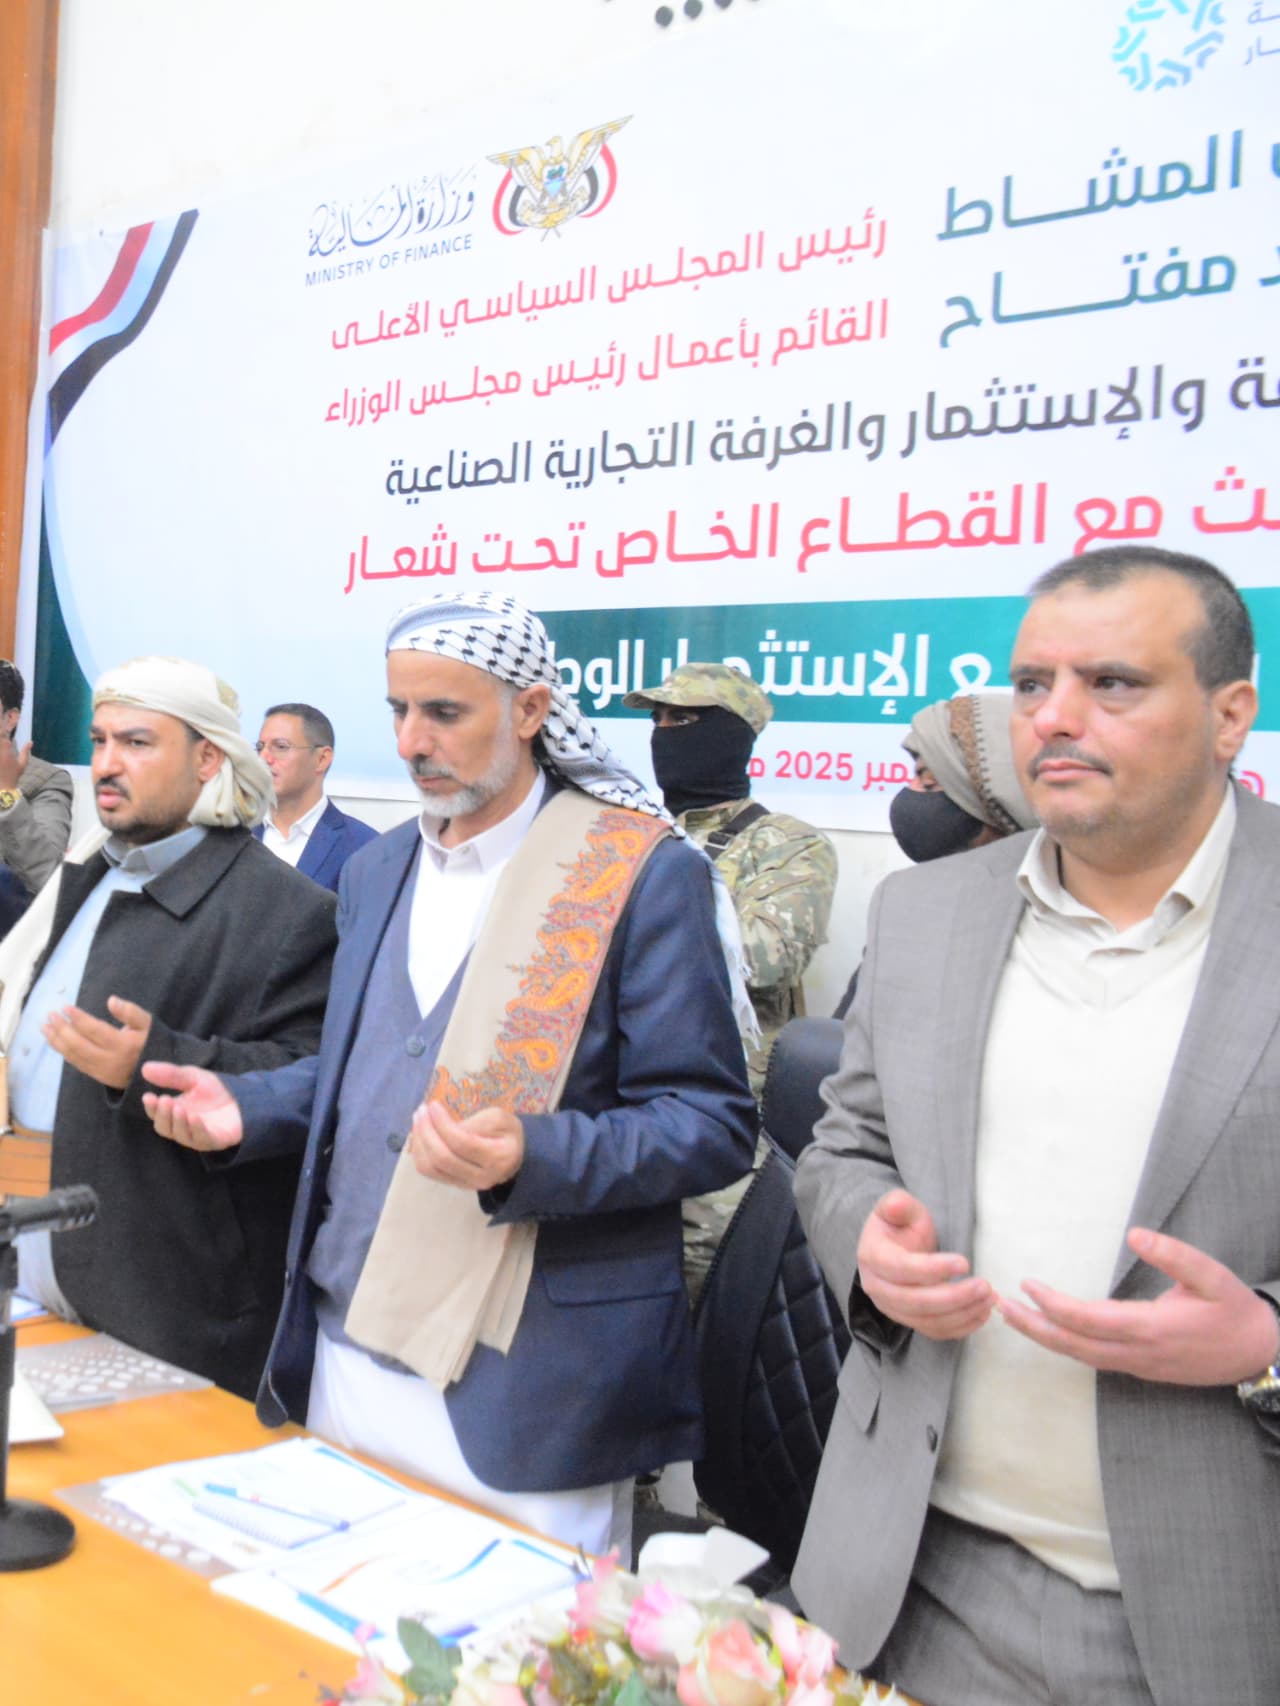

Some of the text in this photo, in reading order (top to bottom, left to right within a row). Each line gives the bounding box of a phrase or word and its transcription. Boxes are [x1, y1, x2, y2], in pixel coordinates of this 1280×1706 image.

[936, 129, 1244, 241] المشاط
[305, 233, 473, 287] MINISTRY OF FINANCE
[331, 207, 887, 350] رئيس المجلس السياسي الأعلى
[939, 245, 1239, 350] مفتاح
[324, 297, 889, 428] القائم بأعمال رئيس مجلس الوزراء
[709, 400, 887, 472] والغرفة
[900, 363, 1207, 460] والإستثمار
[385, 439, 533, 506] الصناعية
[544, 419, 696, 489] التجارية
[343, 522, 458, 595] شعار
[471, 520, 587, 574] تحت
[594, 501, 780, 579] الخاص
[796, 481, 1048, 574] القطاع
[1074, 495, 1164, 557] مع
[775, 750, 854, 782] 2025
